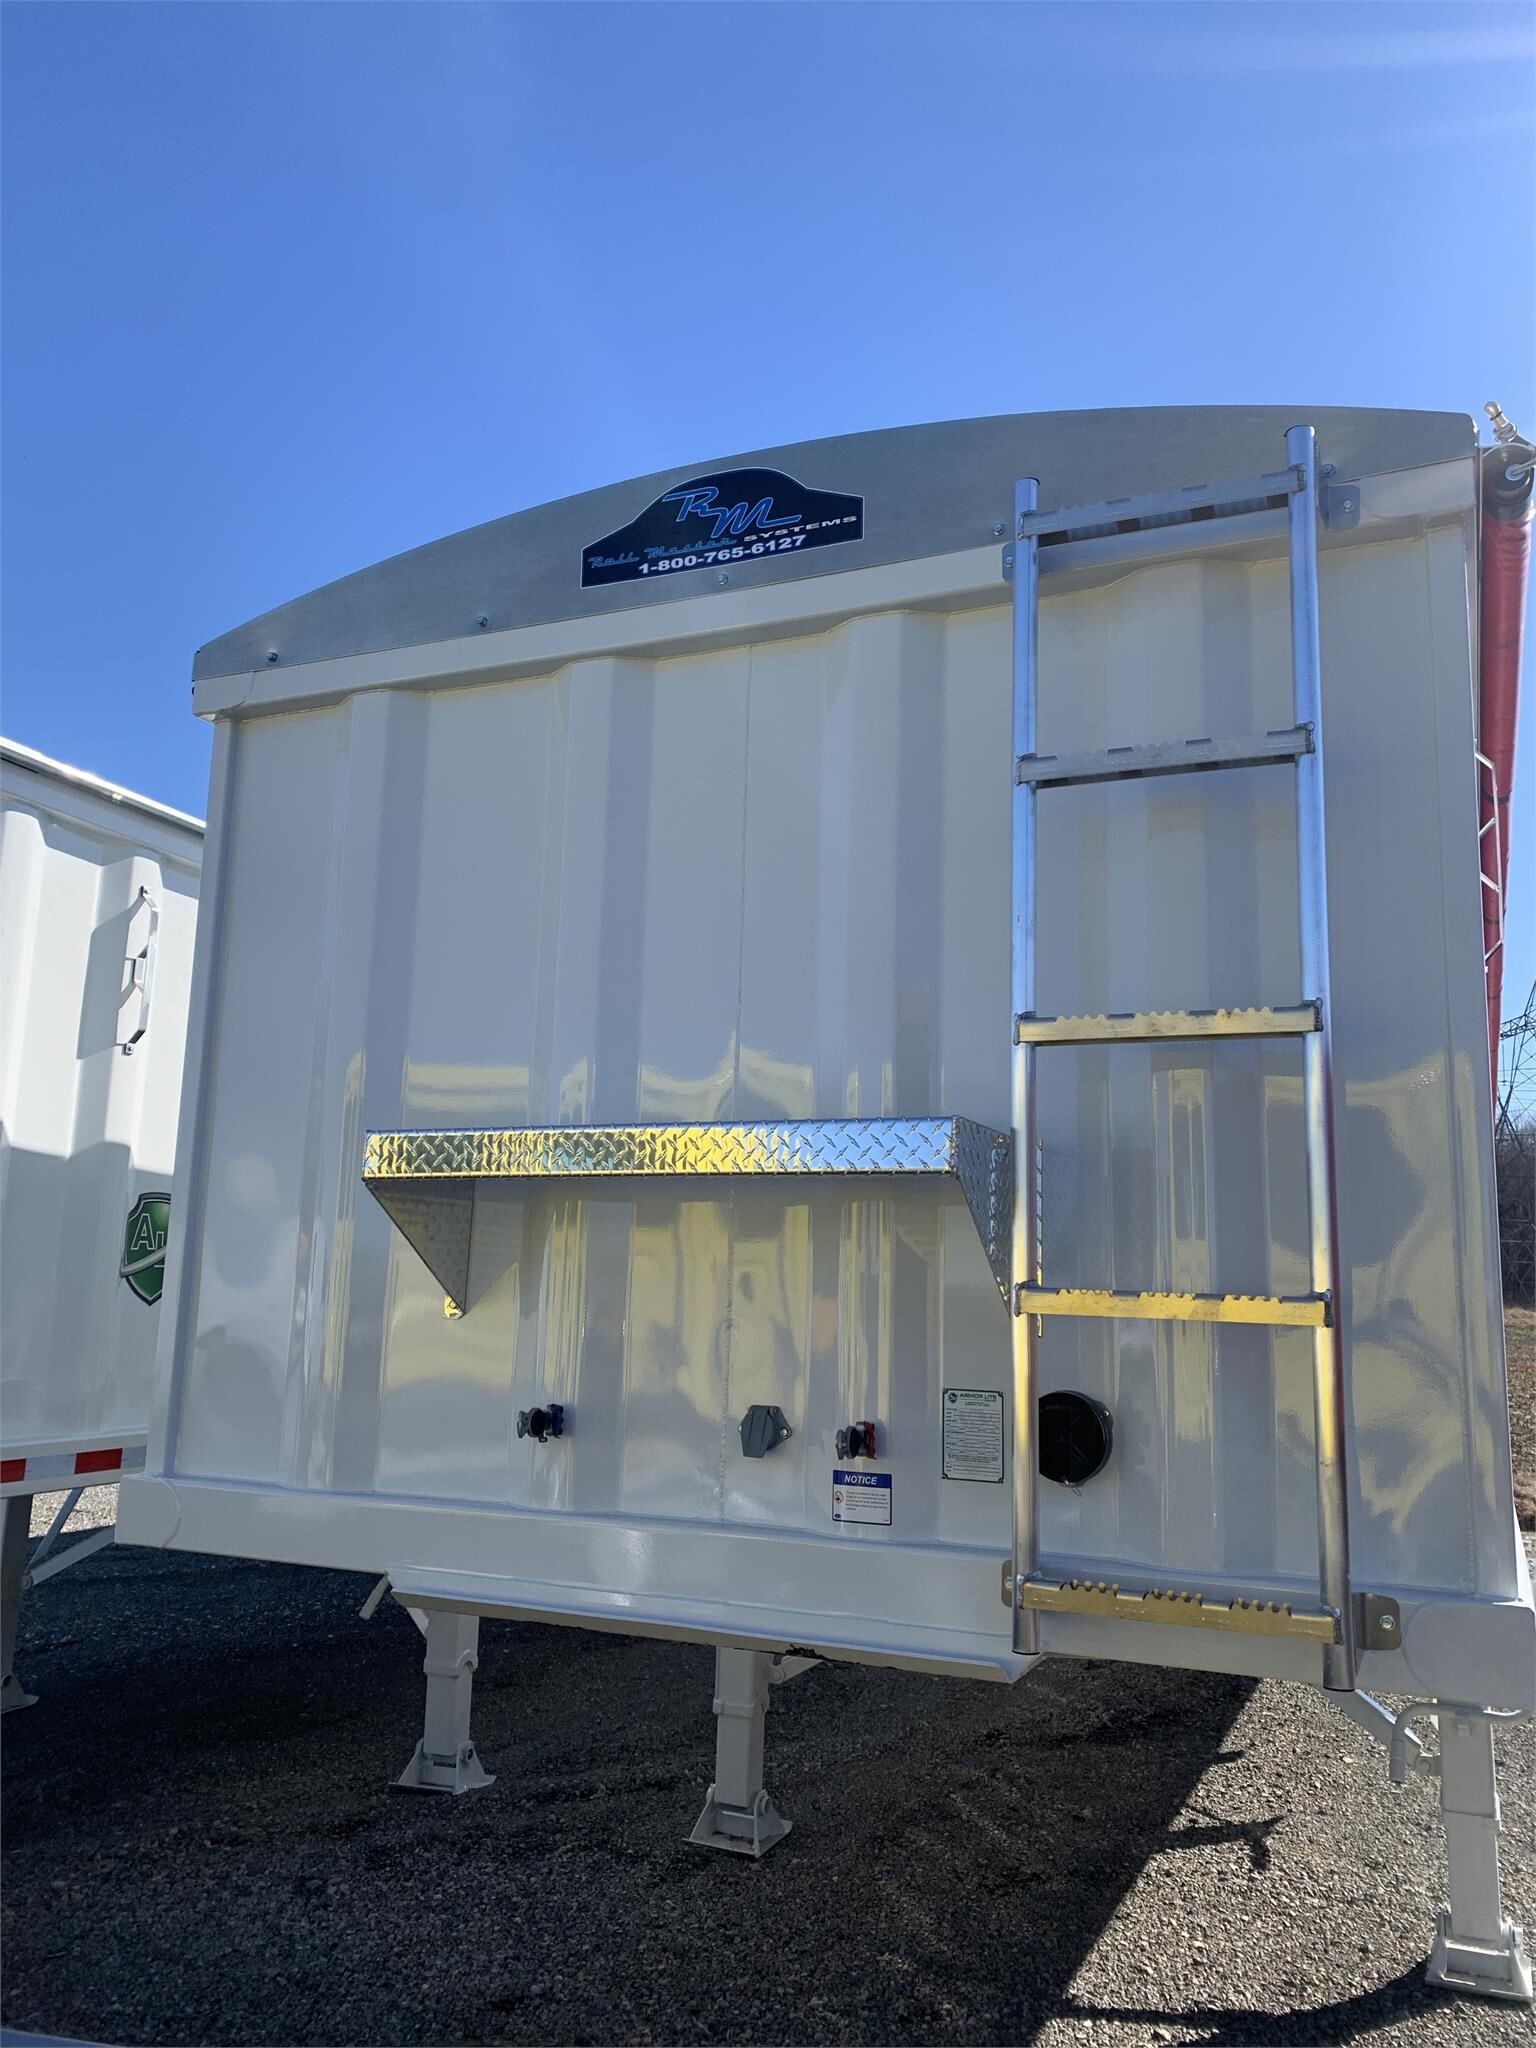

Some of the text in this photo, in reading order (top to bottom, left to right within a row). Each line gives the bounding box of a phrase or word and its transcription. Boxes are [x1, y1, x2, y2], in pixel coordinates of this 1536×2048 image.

[588, 515, 858, 569] Roll Master SYSTEMS
[638, 534, 807, 574] 1-800-765-6127
[844, 1474, 878, 1485] NOTICE
